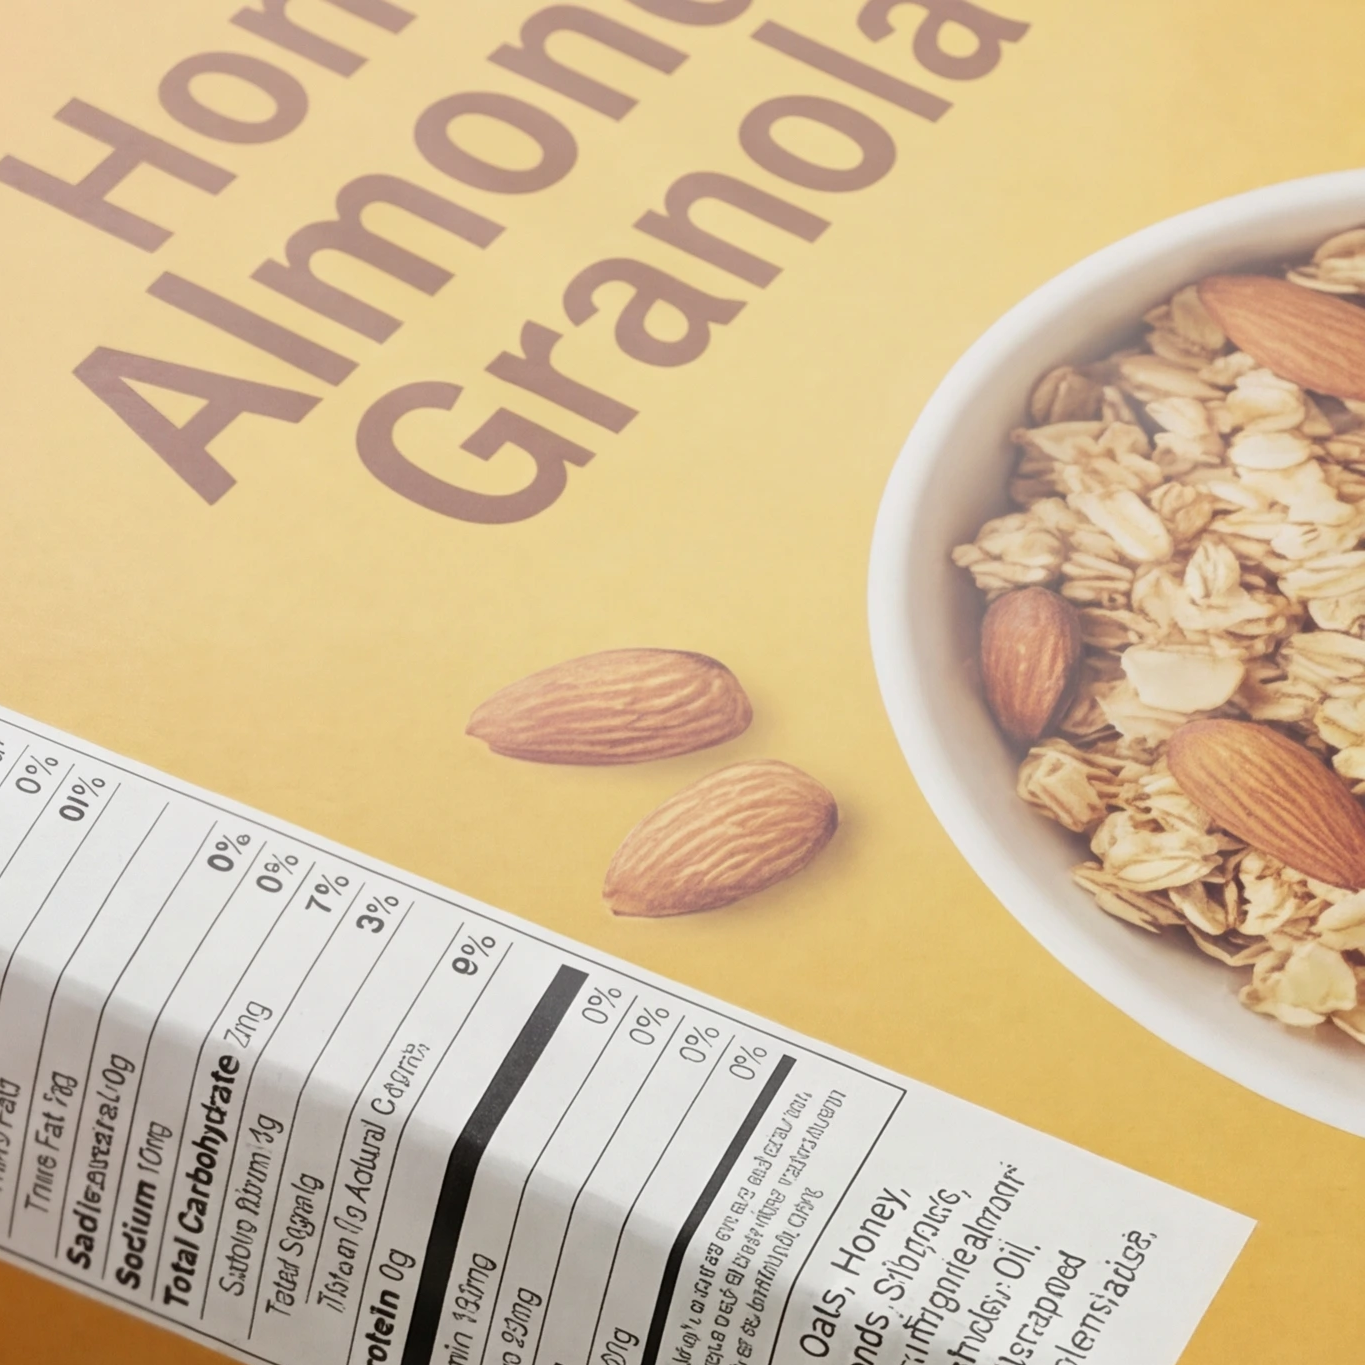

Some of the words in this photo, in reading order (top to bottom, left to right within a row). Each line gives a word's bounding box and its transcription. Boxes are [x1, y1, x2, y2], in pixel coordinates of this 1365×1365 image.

[71, 0, 755, 506] Almon
[355, 0, 1032, 525] Granola
[14, 754, 59, 795] 0%
[355, 895, 400, 935] 3%
[161, 1234, 201, 1308] Total
[304, 873, 350, 914] 7%
[113, 1178, 158, 1292] Sodium
